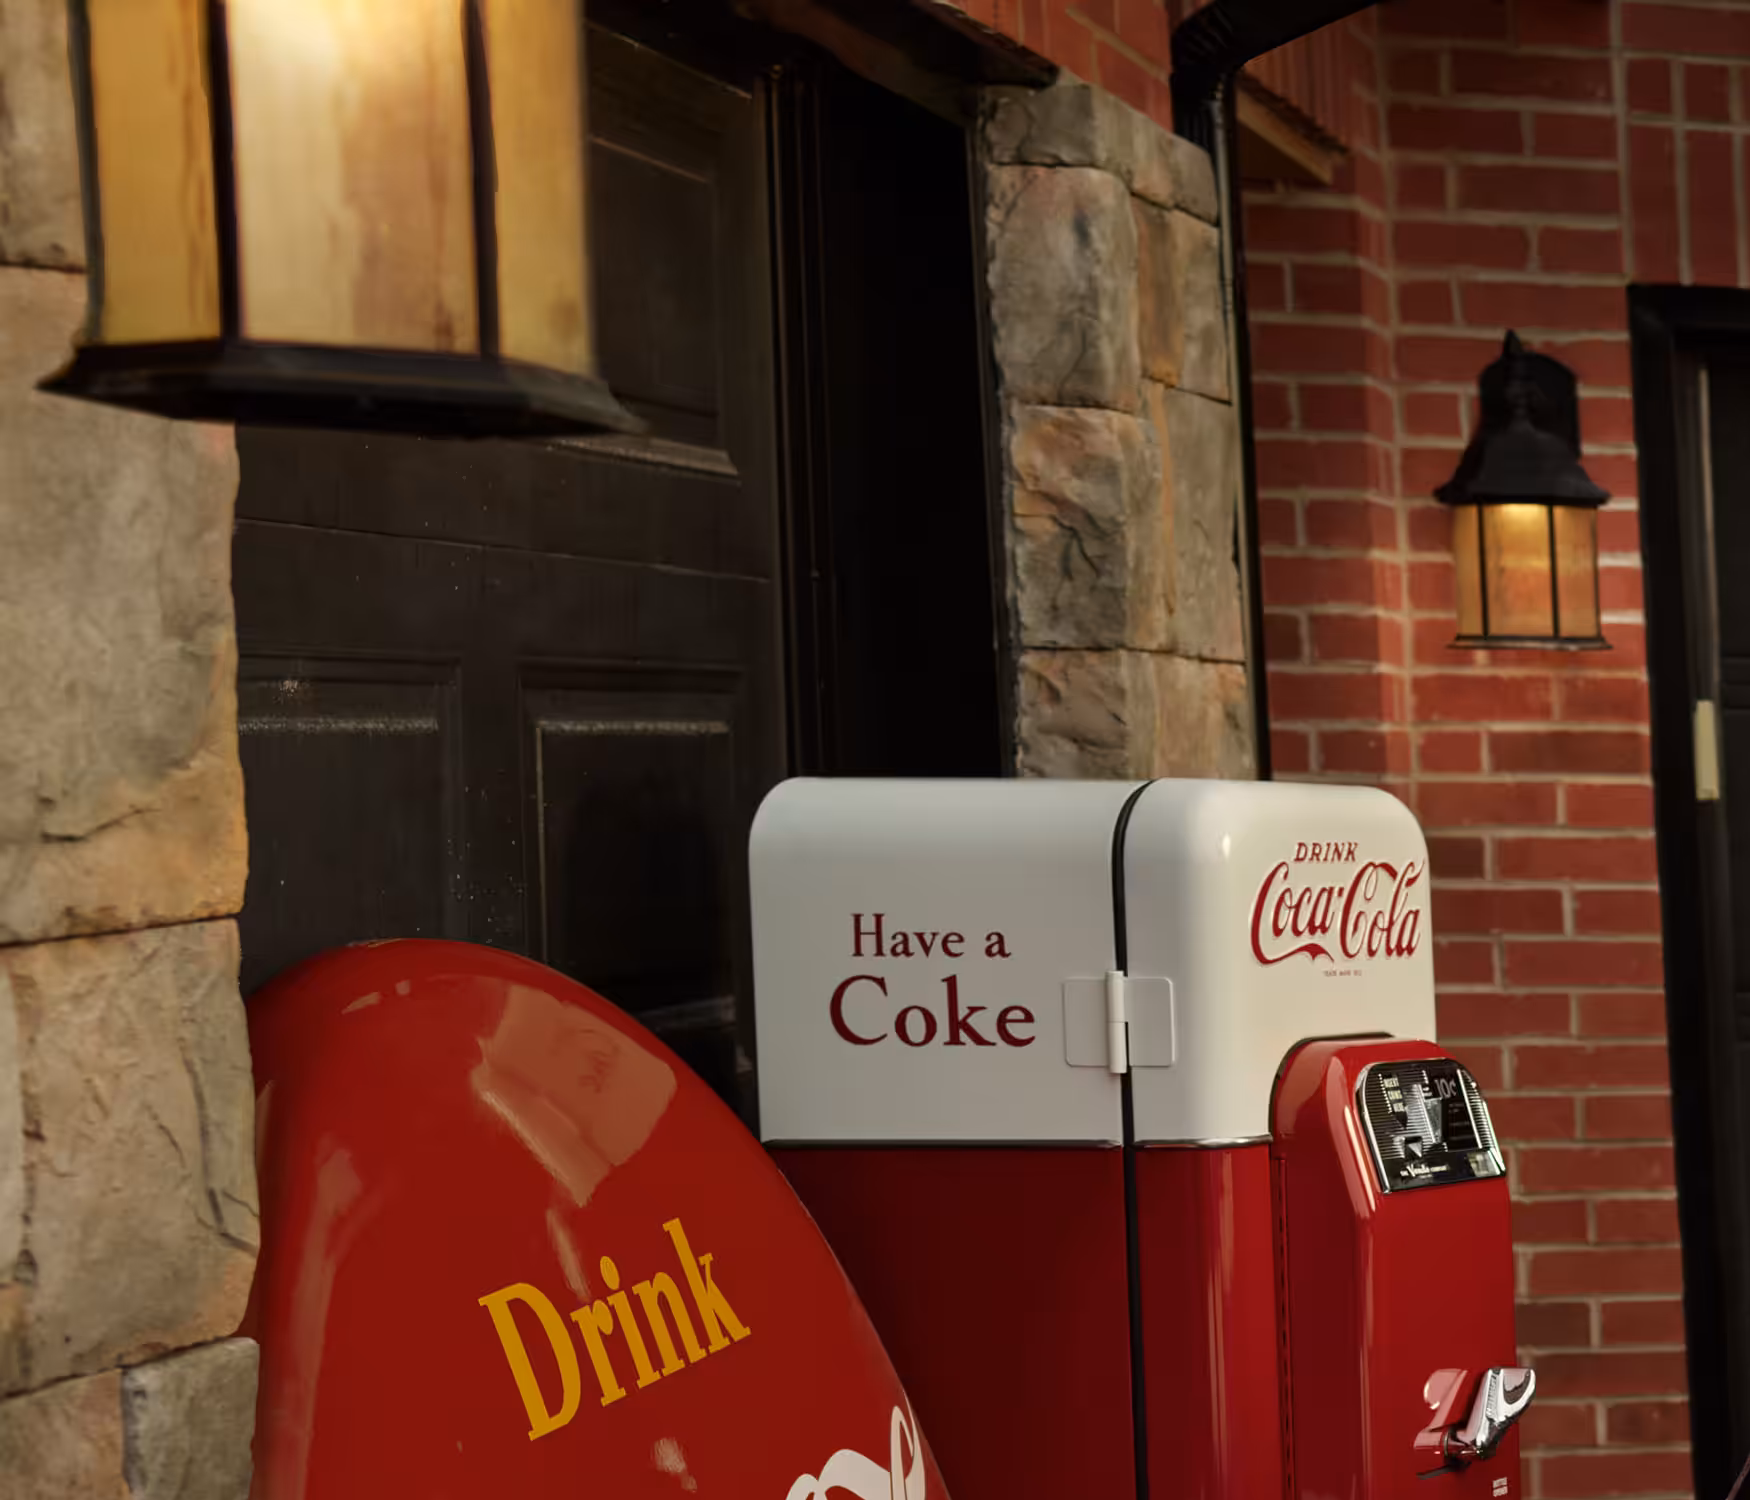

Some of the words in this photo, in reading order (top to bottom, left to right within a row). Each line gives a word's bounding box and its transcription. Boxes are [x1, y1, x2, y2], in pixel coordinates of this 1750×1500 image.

[1294, 841, 1358, 862] DRINK
[852, 913, 965, 958] Have
[984, 931, 1011, 958] a
[1251, 858, 1424, 965] Coca-Cola
[829, 975, 1036, 1047] Coke
[479, 1218, 751, 1441] Drink
